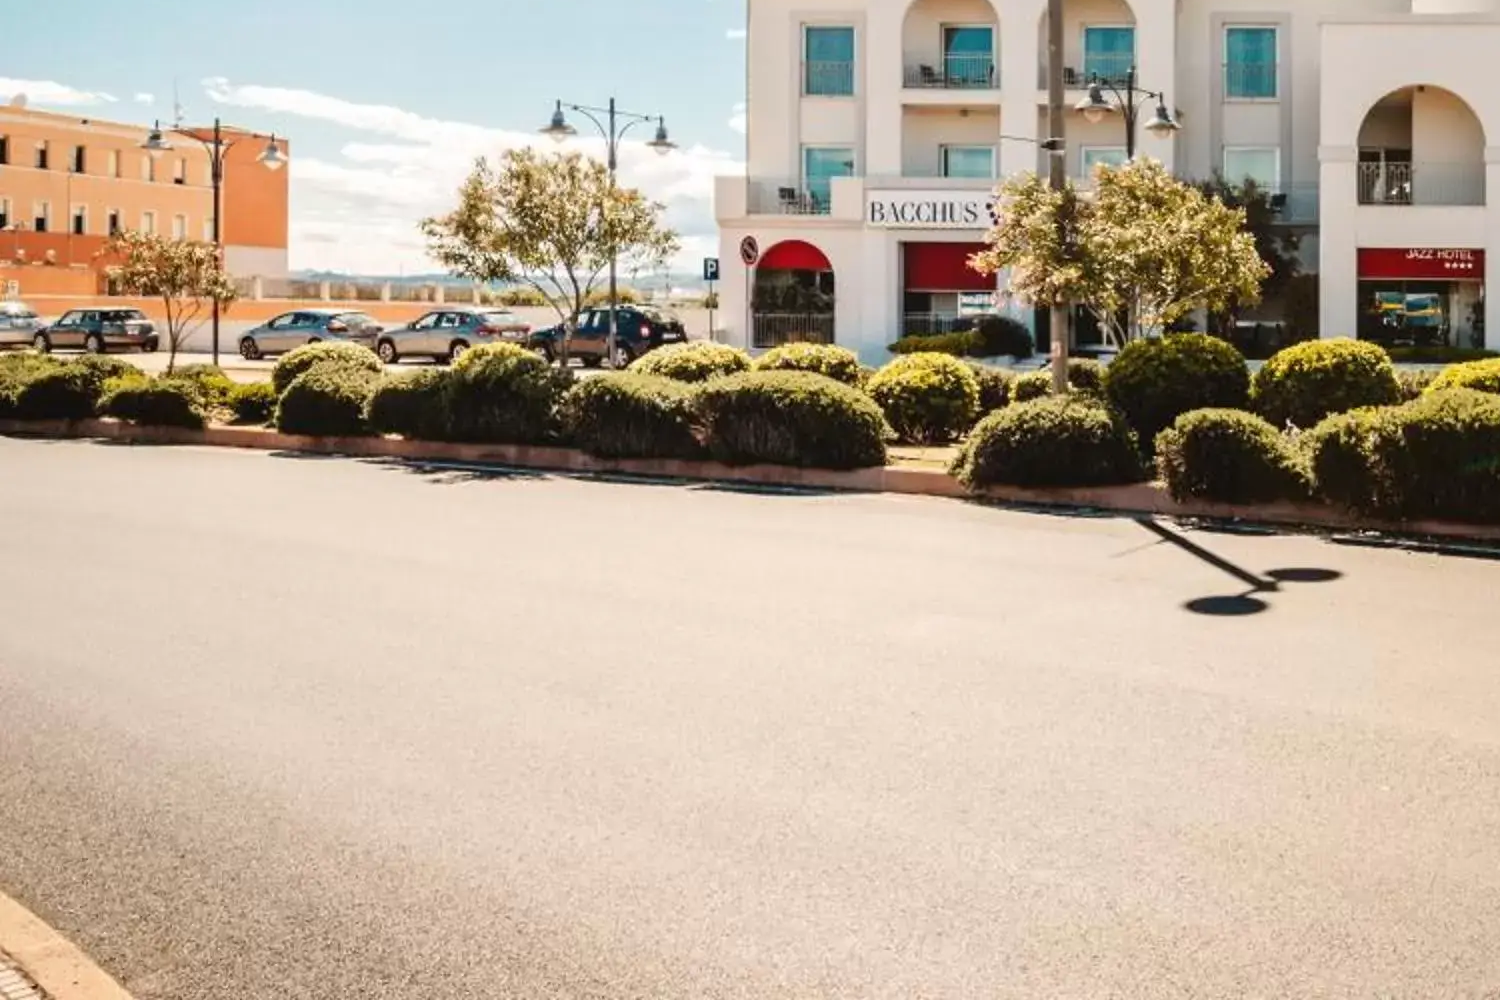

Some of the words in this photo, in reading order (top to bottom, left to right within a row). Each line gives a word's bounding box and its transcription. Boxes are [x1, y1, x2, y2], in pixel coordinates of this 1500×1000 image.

[870, 200, 979, 223] BACCHUS
[1405, 248, 1433, 260] JAZZ
[1437, 248, 1474, 260] HOTEL
[707, 260, 717, 278] P
